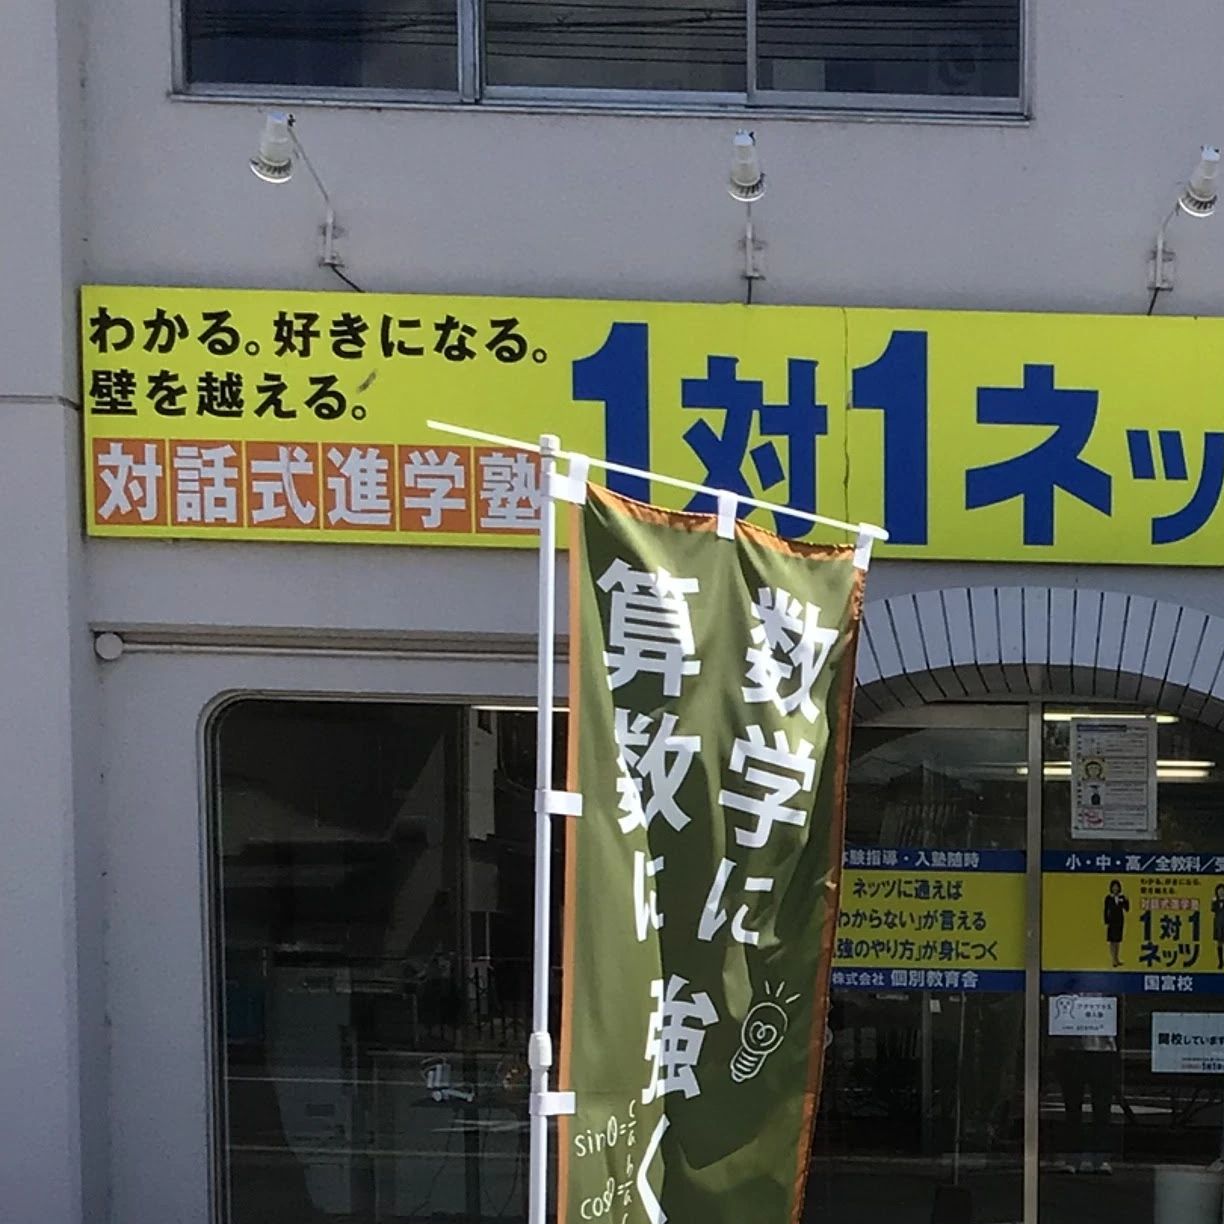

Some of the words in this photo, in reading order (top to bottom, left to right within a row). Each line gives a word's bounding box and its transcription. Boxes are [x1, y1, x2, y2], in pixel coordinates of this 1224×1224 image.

[88, 306, 548, 364] わかる。好きになる。
[89, 369, 367, 421] 壁を越える。
[97, 442, 541, 530] 対話式進学塾
[698, 586, 839, 946] 数学に
[835, 938, 998, 962] 強のやり方」が身につく
[1139, 941, 1201, 967] ネッツ
[832, 971, 885, 986] 株式会社
